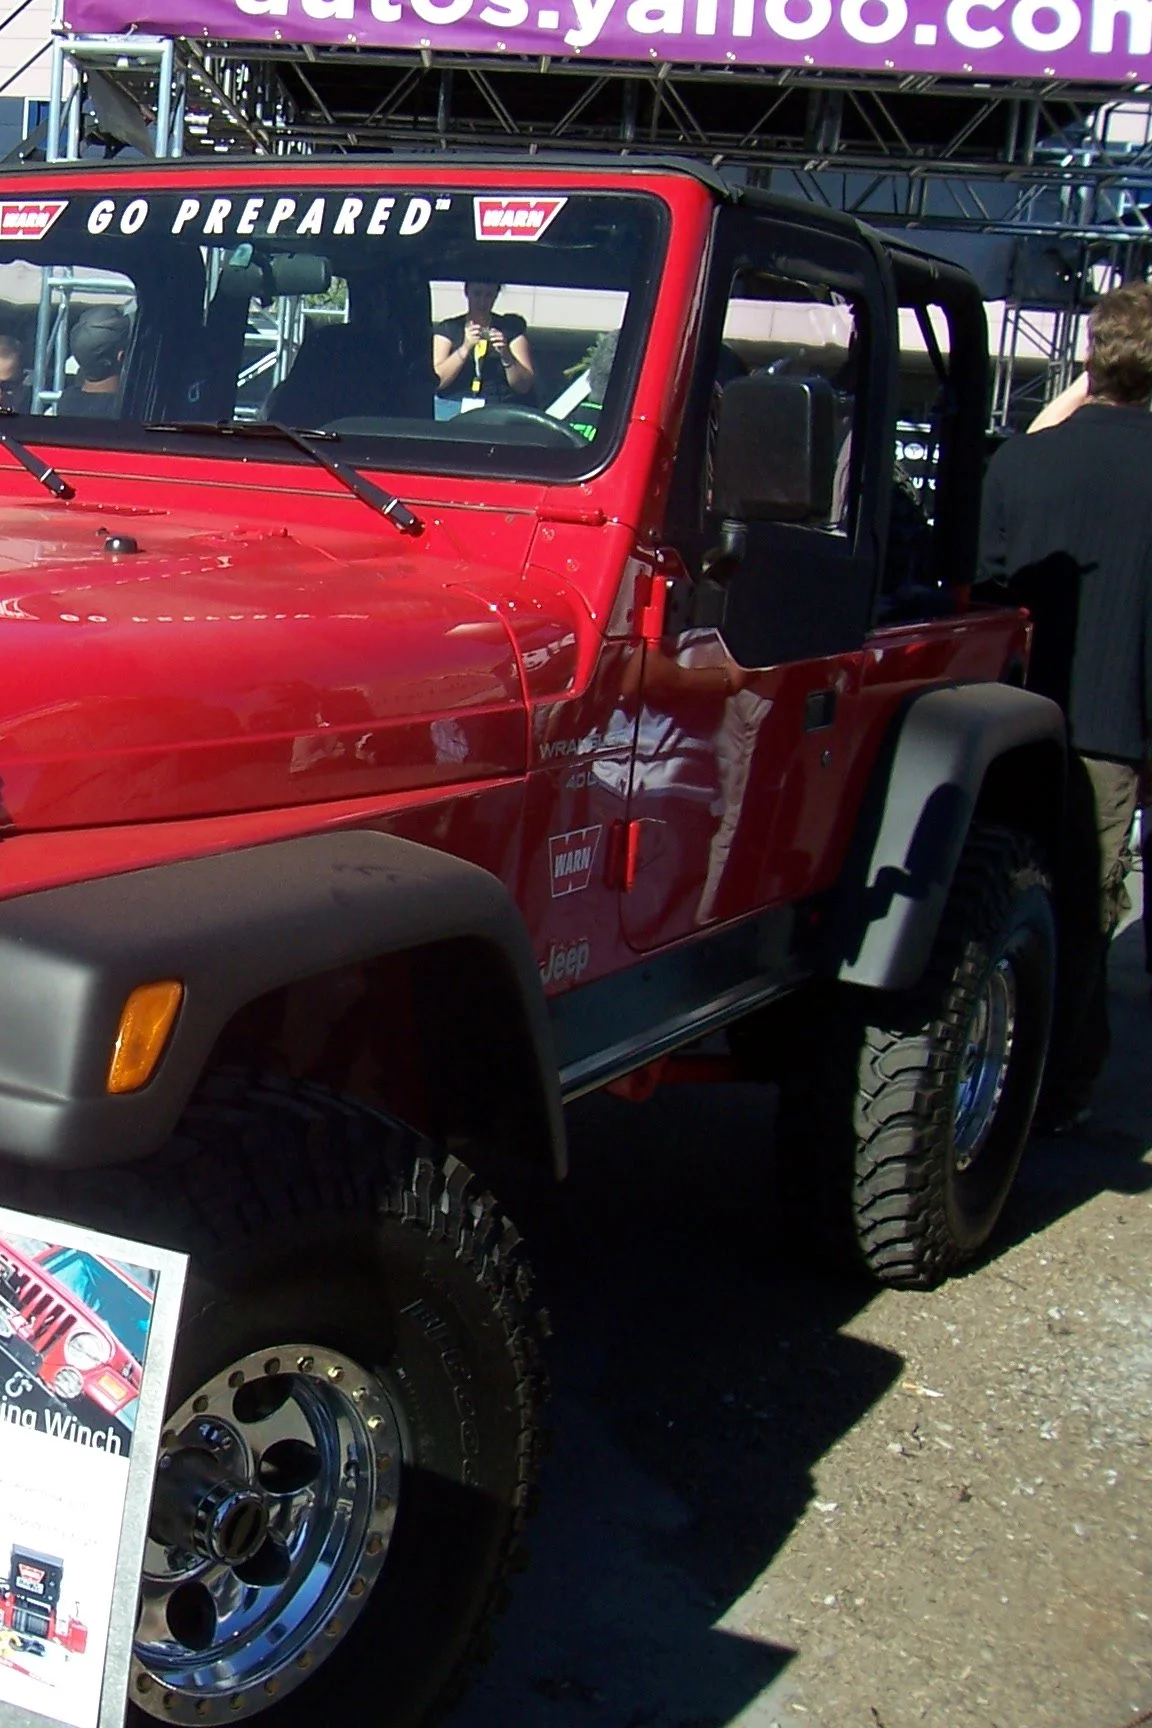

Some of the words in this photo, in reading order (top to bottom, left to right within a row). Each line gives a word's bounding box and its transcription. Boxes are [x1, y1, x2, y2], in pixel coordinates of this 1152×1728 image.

[237, 0, 1152, 54] .yaoo.co
[2, 210, 50, 228] WARN
[87, 198, 149, 235] GO
[482, 209, 545, 228] WARN
[555, 847, 591, 878] WARN
[540, 940, 590, 985] Jeep
[44, 1408, 123, 1456] Winch
